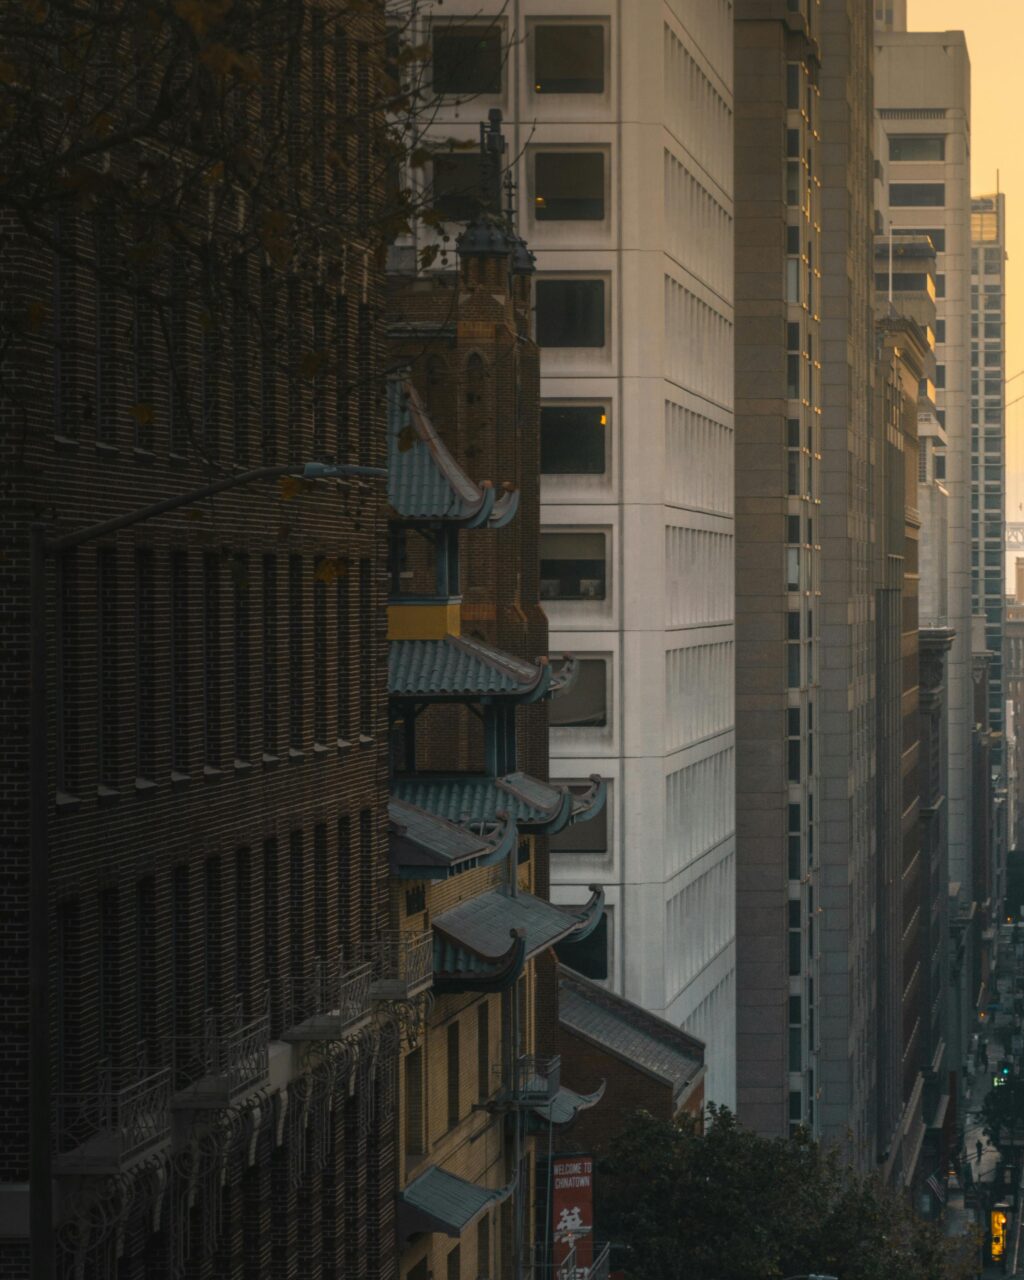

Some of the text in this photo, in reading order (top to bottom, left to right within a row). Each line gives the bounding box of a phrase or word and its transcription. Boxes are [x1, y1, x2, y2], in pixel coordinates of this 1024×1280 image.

[553, 1162, 592, 1176] WELCOME TO
[555, 1176, 590, 1189] CHINATOWN
